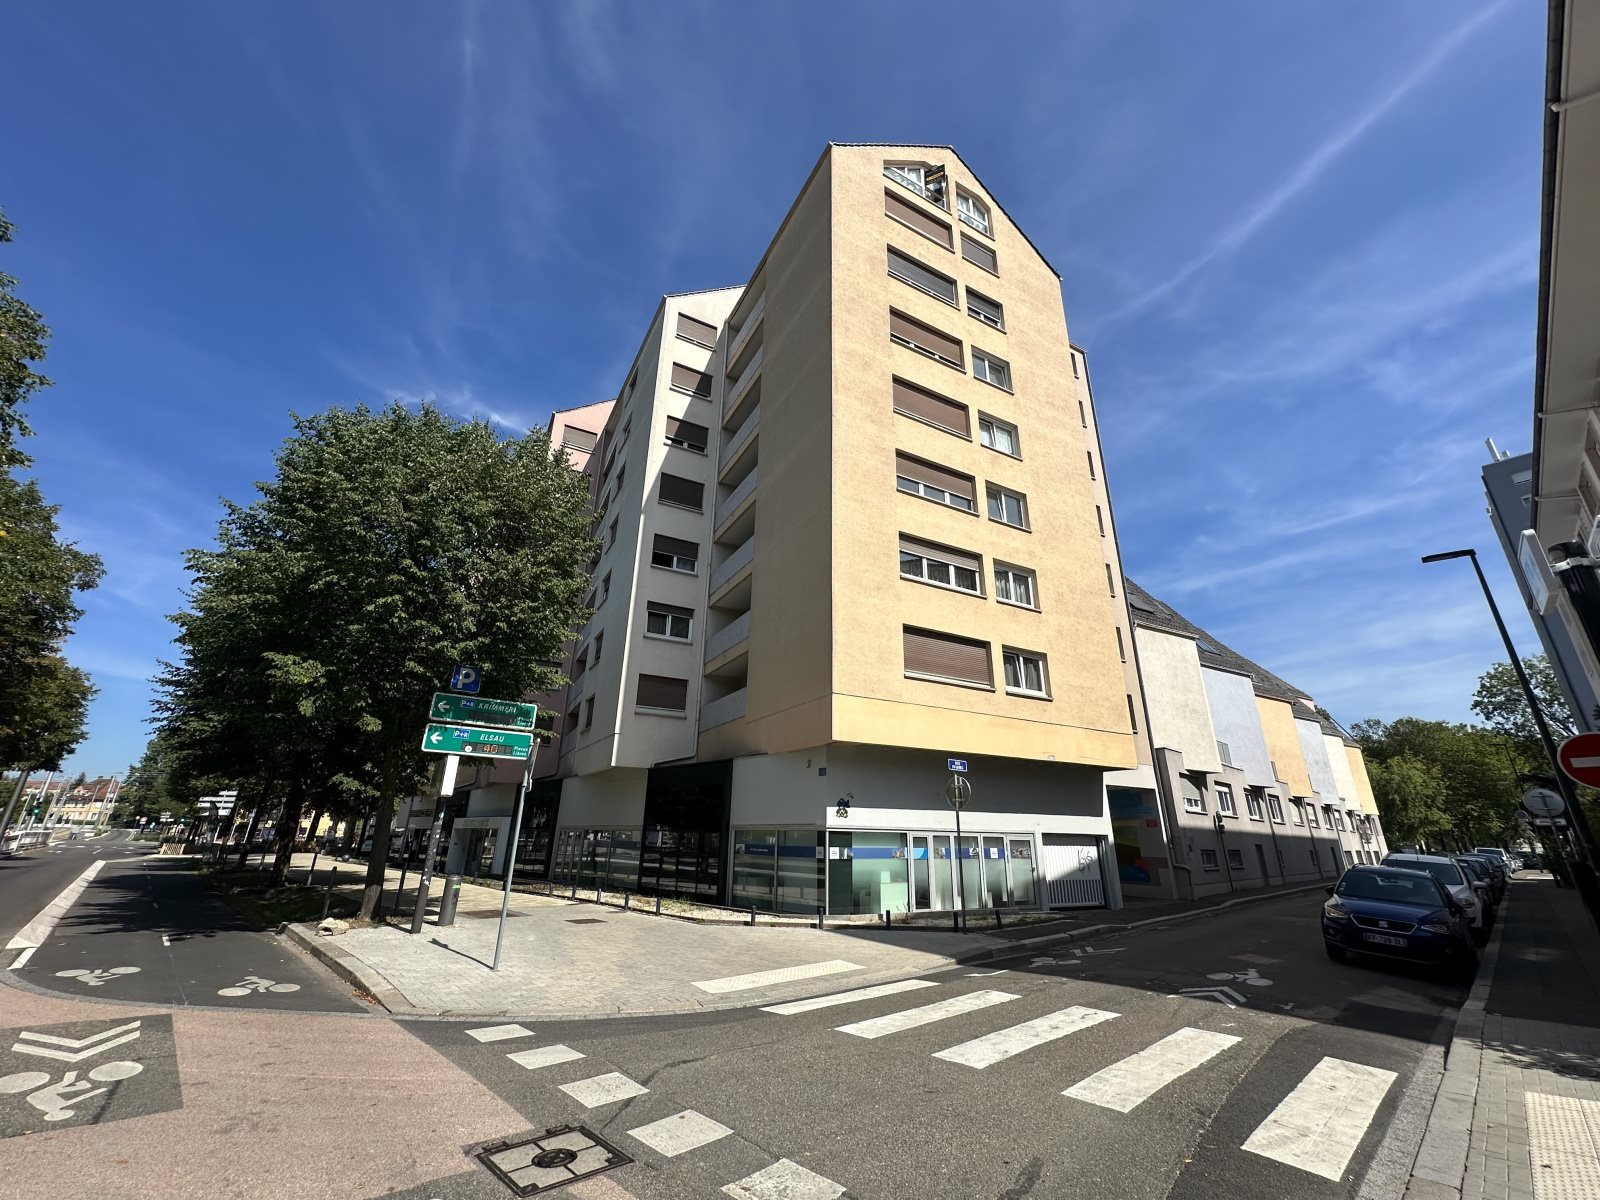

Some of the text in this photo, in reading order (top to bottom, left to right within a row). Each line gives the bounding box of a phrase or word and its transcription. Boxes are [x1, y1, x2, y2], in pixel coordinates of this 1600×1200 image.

[457, 667, 476, 688] P
[454, 730, 504, 743] P+R ELSAU
